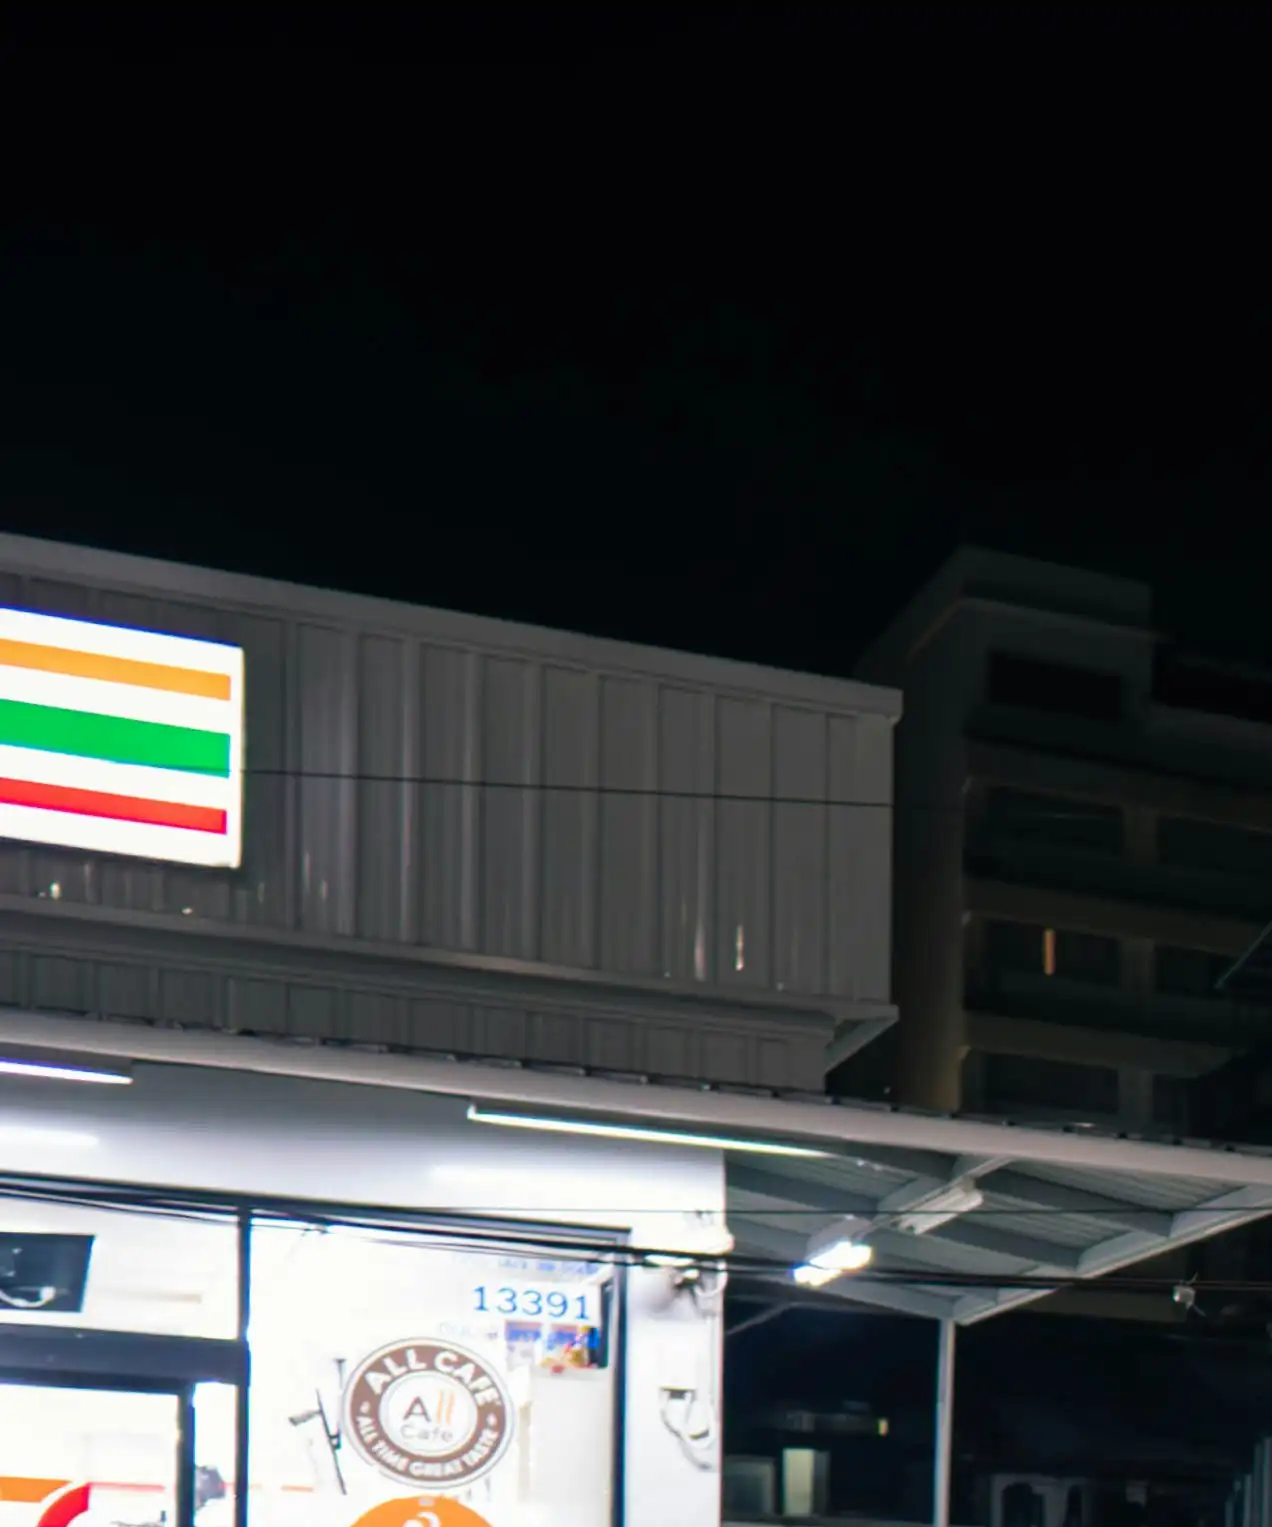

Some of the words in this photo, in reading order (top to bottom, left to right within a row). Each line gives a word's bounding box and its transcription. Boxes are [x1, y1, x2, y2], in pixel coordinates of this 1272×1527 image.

[473, 1286, 590, 1320] 13391
[364, 1348, 427, 1395] ALL
[434, 1351, 502, 1406] CAFE
